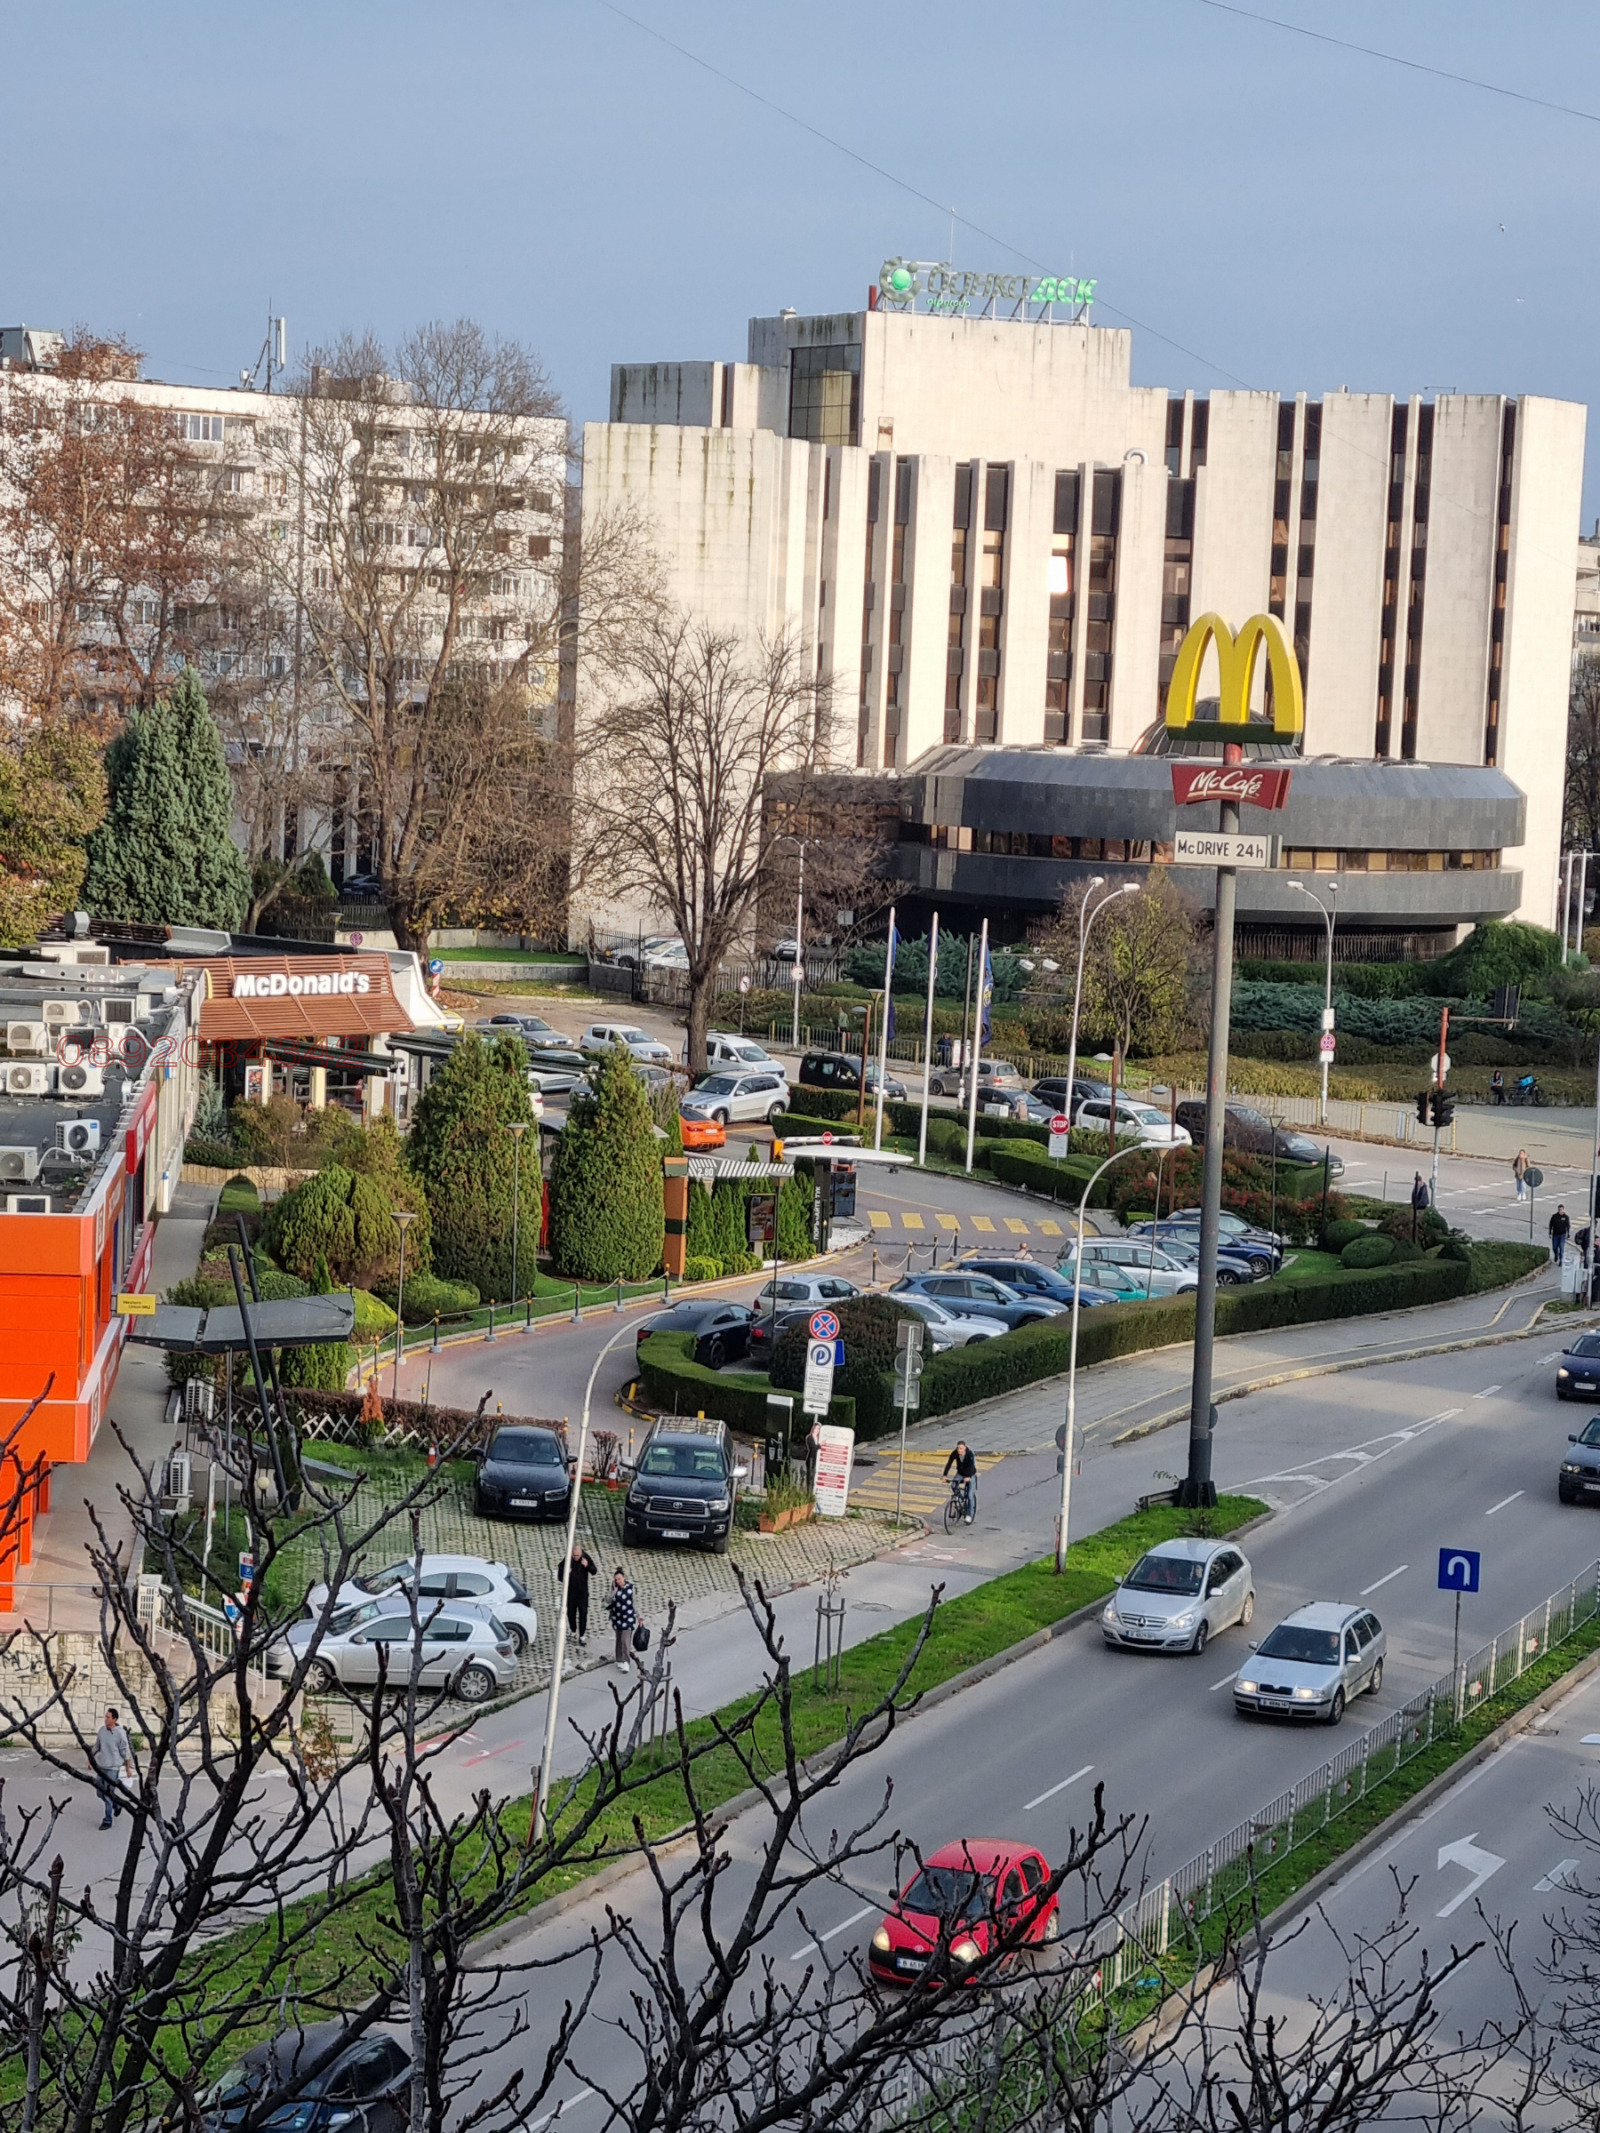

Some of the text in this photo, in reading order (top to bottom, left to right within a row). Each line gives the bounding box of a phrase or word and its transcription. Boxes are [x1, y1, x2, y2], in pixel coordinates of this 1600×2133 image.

[1030, 276, 1097, 304] ДСК
[1189, 769, 1263, 798] McCafé
[1236, 843, 1264, 859] 24h
[232, 972, 370, 997] McDonald's
[1052, 1120, 1068, 1128] STOP
[697, 1167, 714, 1177] 2.80
